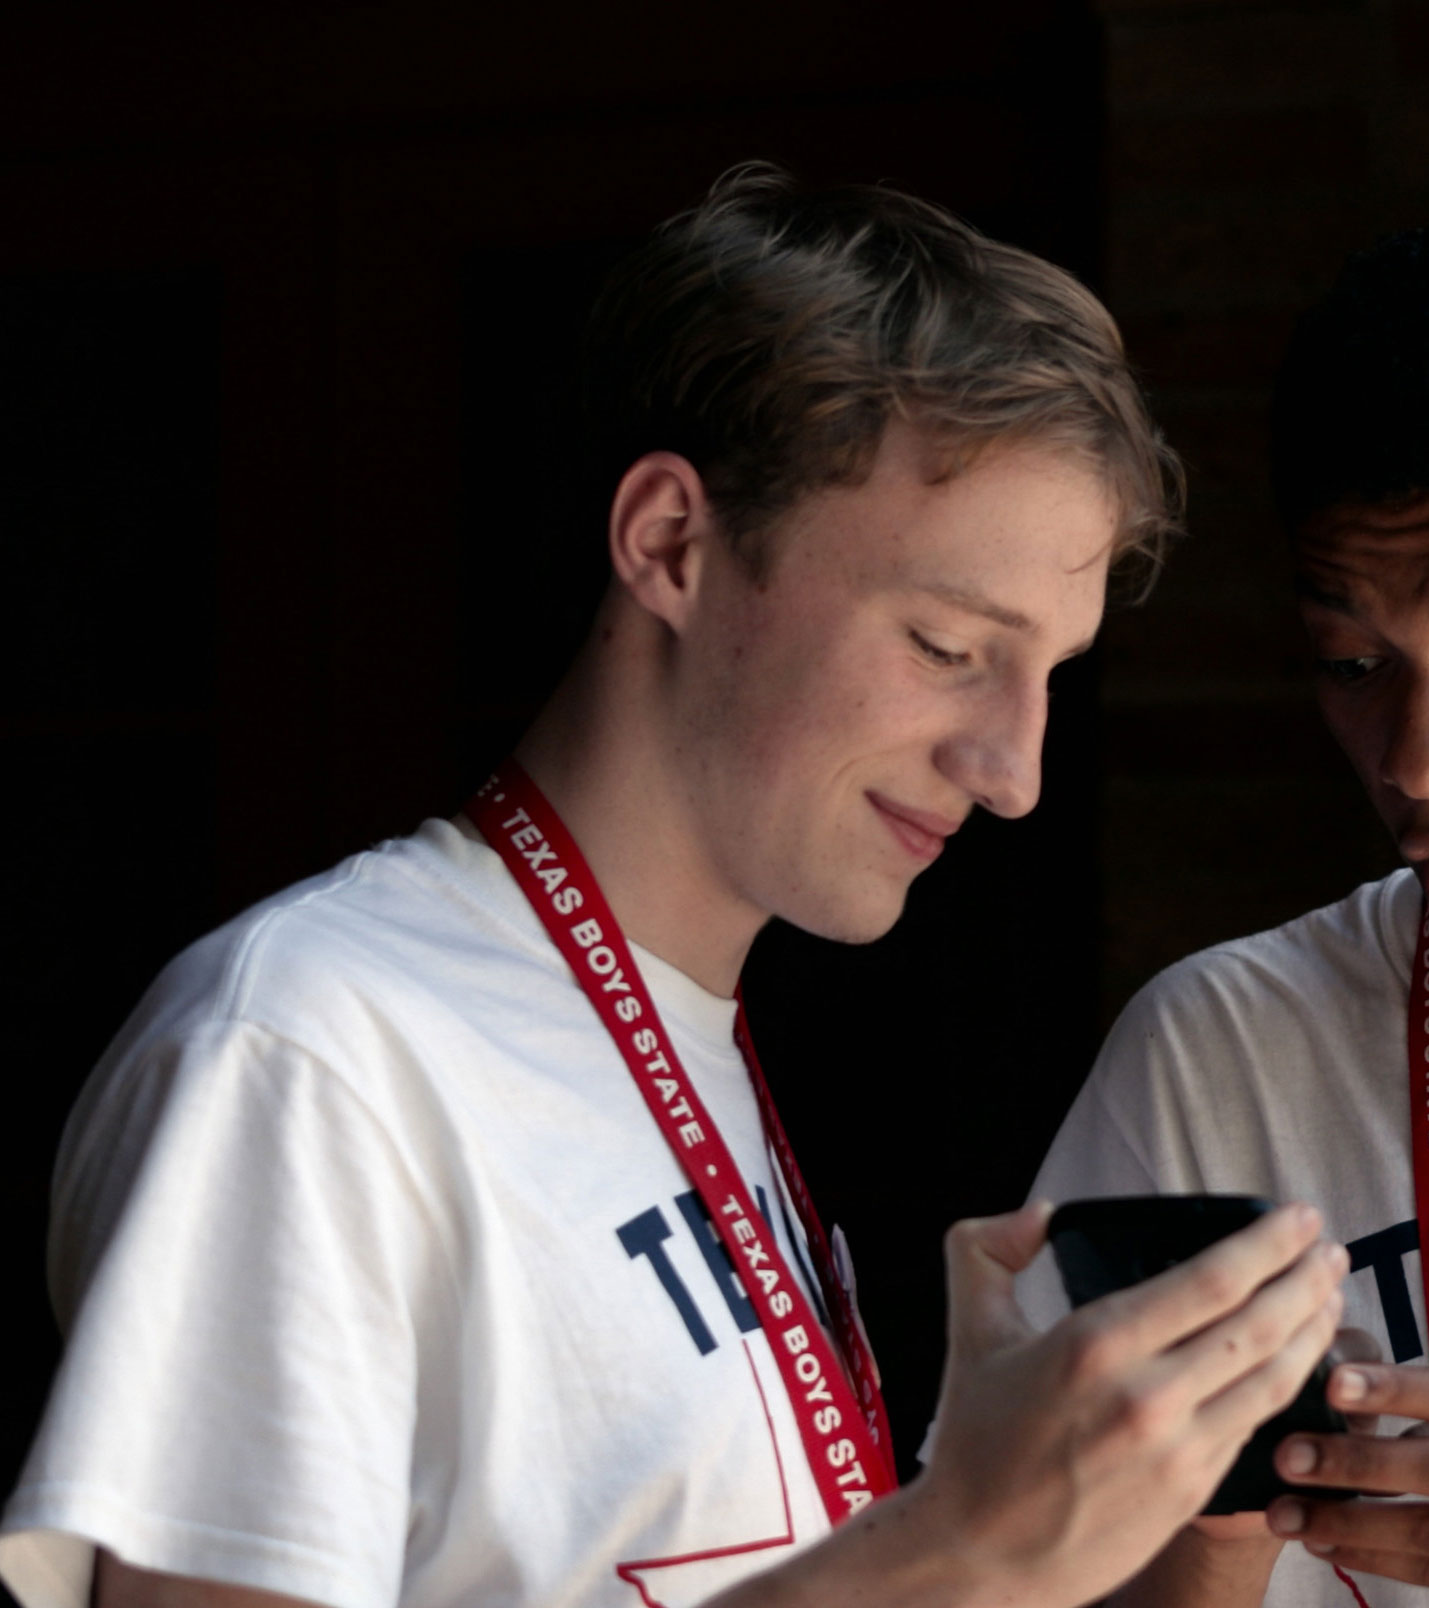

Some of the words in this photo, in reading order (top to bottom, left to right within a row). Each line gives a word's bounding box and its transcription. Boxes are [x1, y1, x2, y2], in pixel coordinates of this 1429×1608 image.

[503, 807, 583, 915] TEXAS
[570, 918, 643, 1023] BOYS
[632, 1028, 706, 1149] STATE
[721, 1194, 793, 1318] TEXAS
[782, 1325, 842, 1435] BOYS
